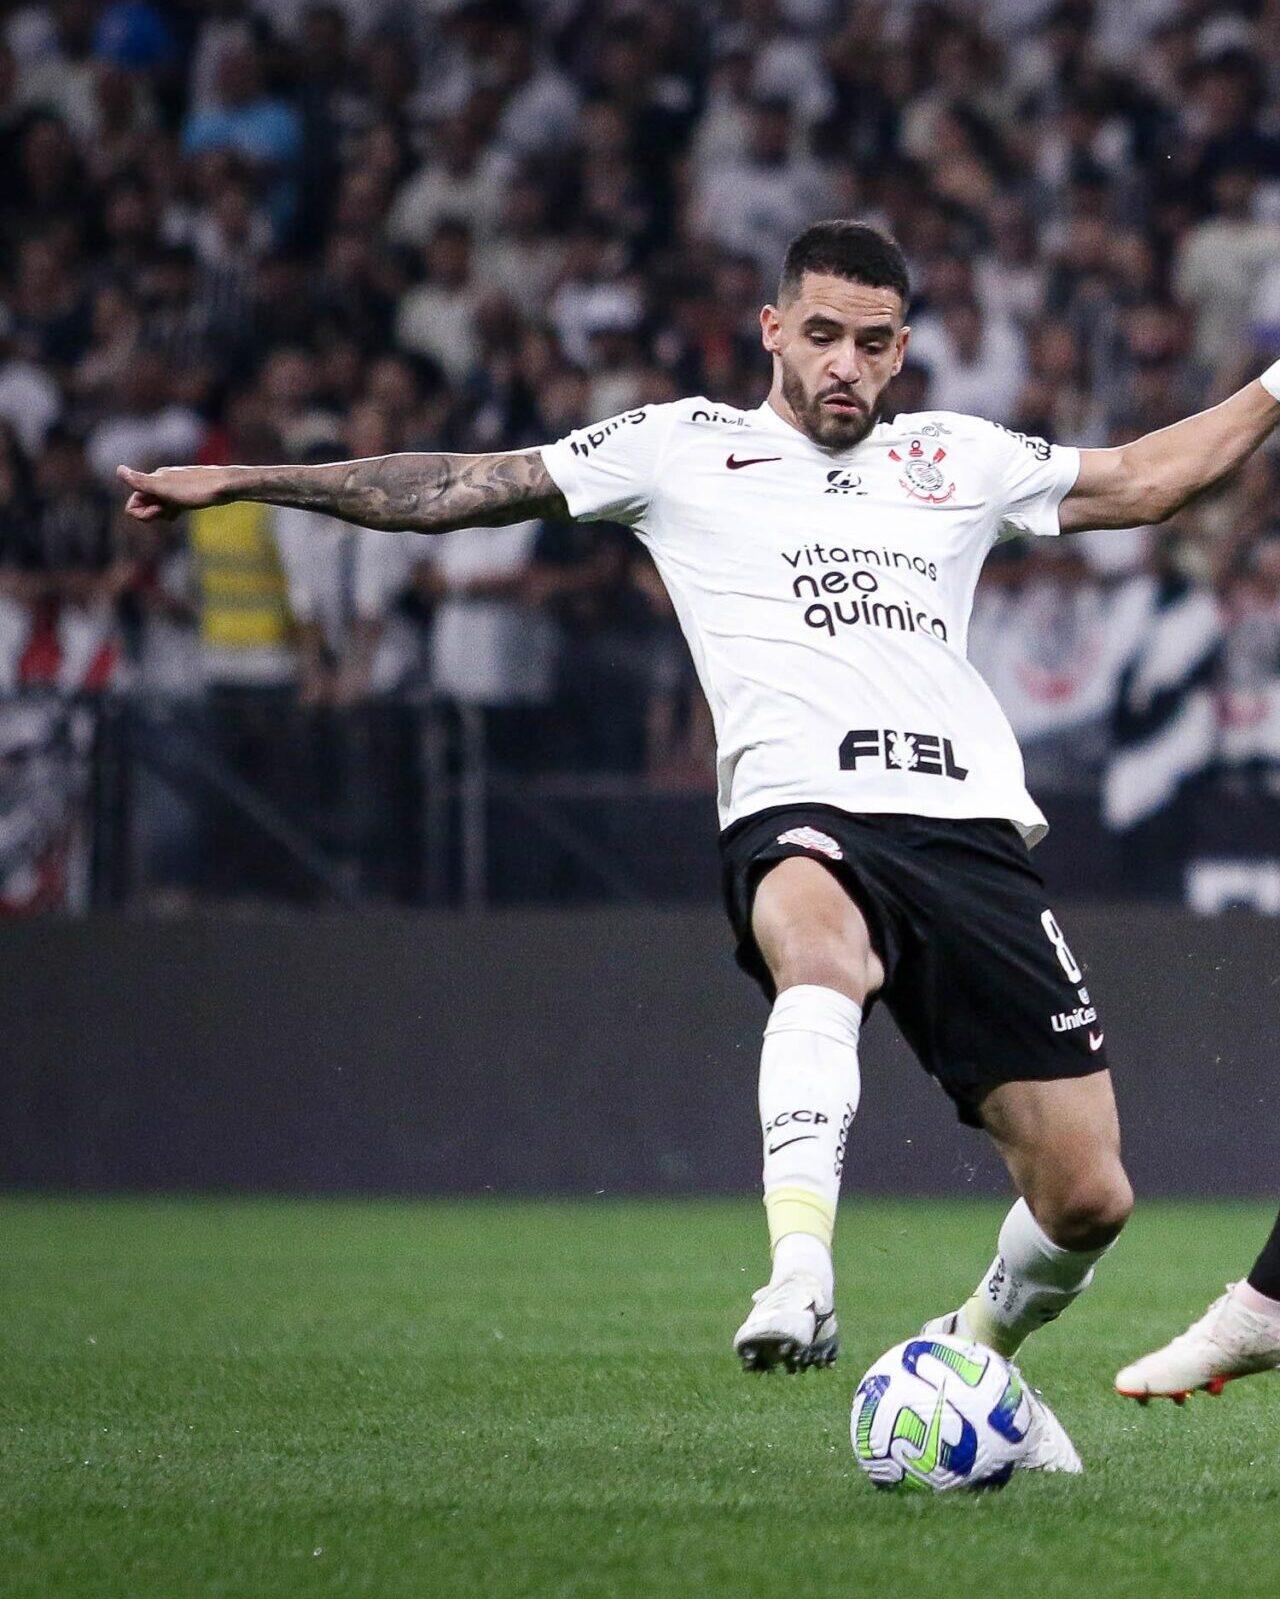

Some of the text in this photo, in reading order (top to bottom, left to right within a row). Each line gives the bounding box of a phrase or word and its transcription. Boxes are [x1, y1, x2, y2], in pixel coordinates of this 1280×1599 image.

[781, 543, 937, 582] vitaminas
[792, 570, 879, 598] neo
[803, 593, 948, 643] química
[1040, 909, 1083, 985] 8
